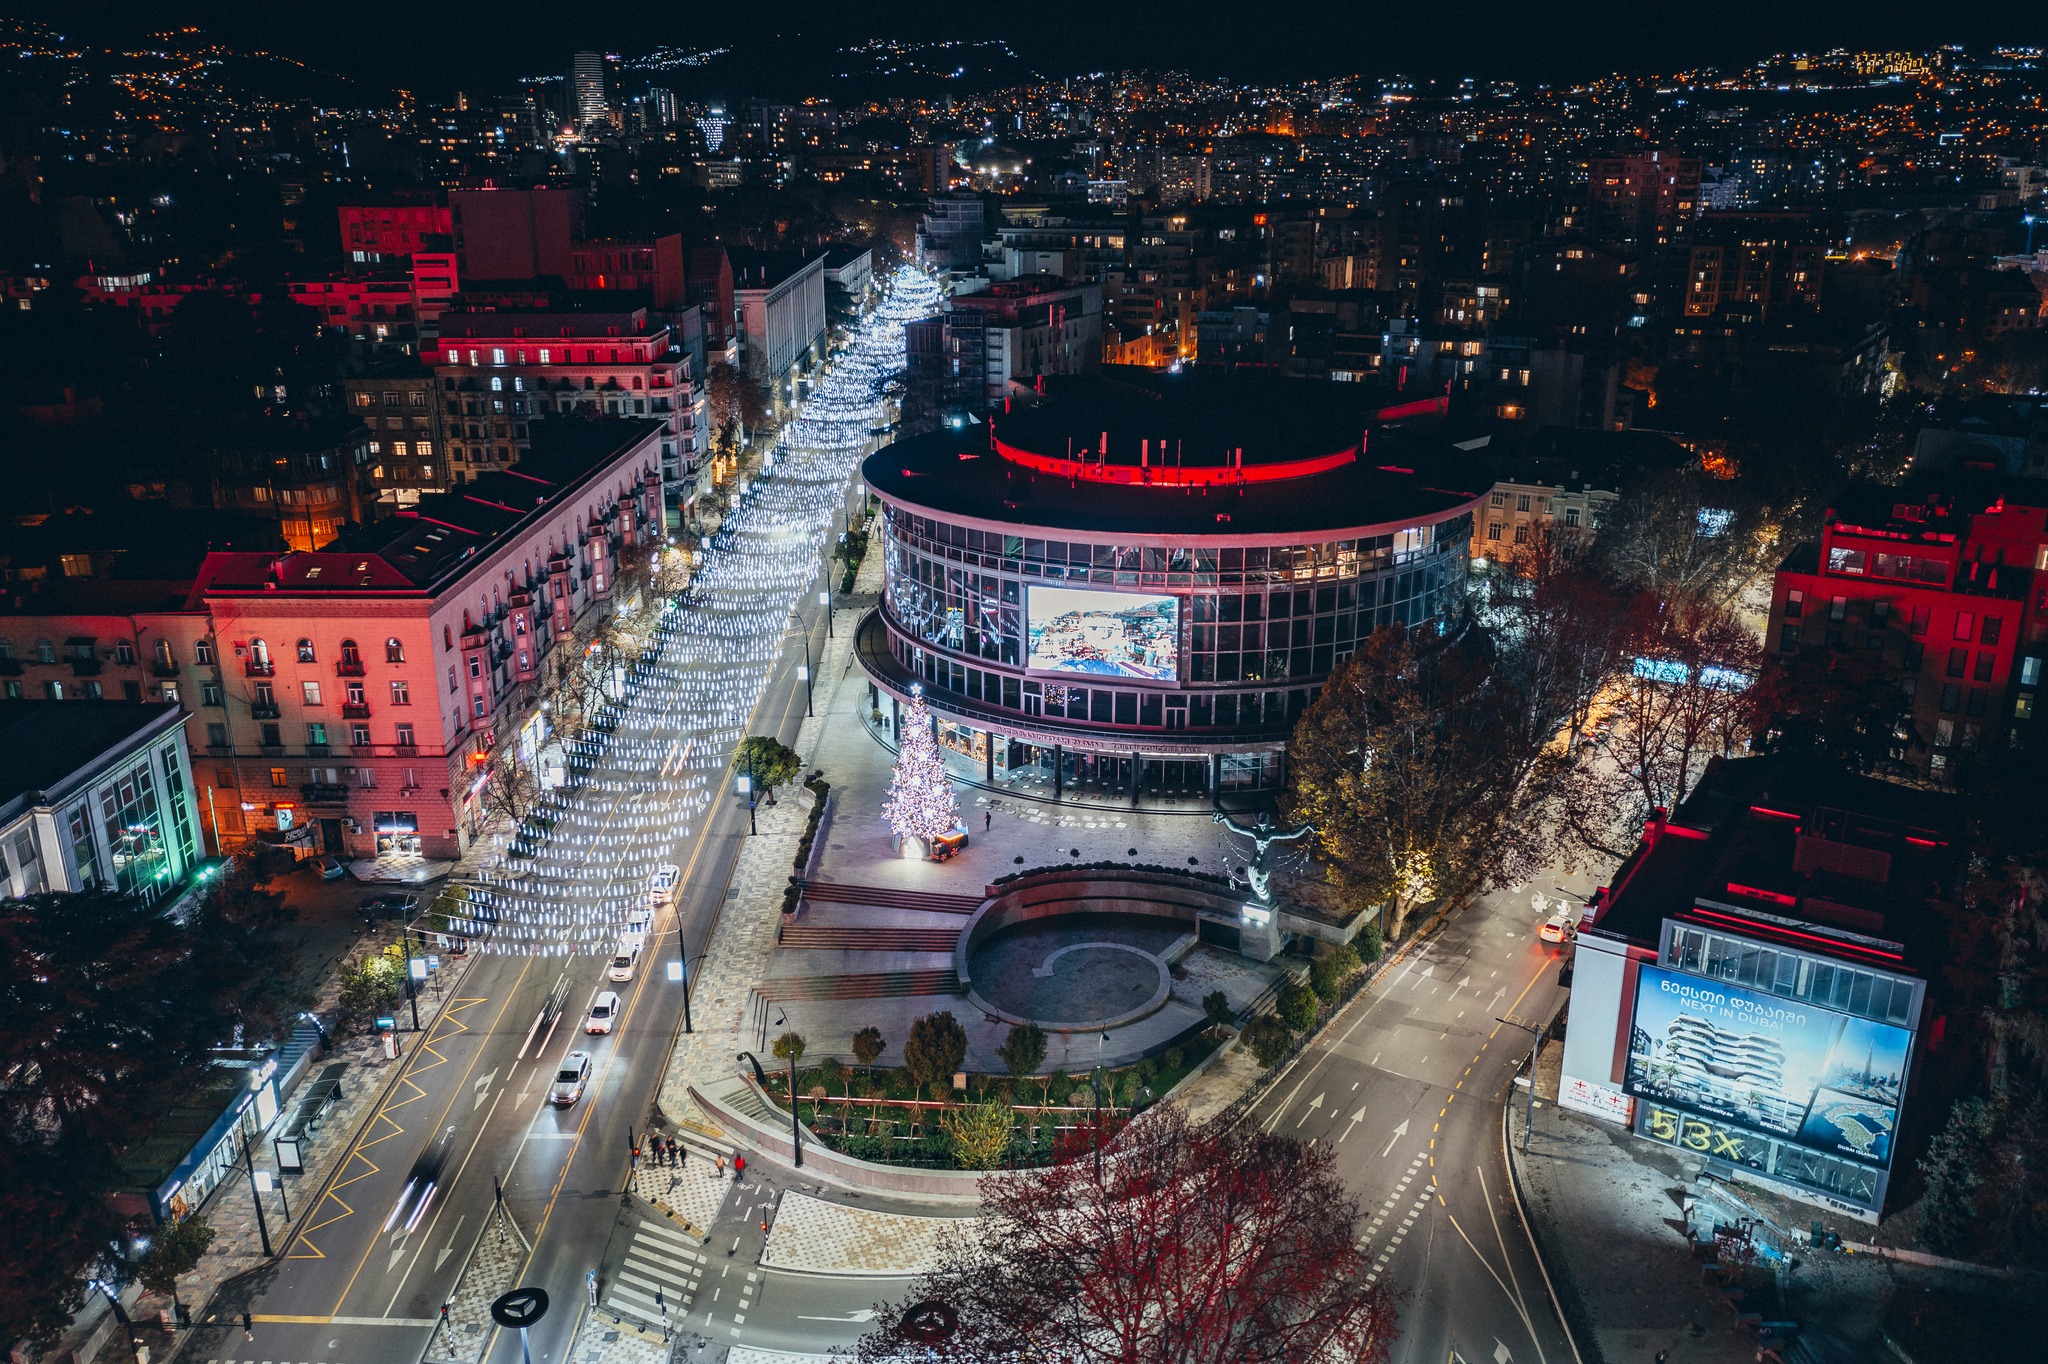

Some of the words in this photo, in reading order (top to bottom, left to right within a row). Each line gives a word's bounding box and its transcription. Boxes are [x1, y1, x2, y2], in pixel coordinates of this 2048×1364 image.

[1140, 745, 1176, 753] CONCERT
[1661, 980, 1725, 1006] ნექსთი
[1730, 997, 1806, 1026] დუბაიში
[1680, 997, 1716, 1014] NEXT
[1719, 1007, 1734, 1019] IN
[1738, 1012, 1783, 1031] DUBAI
[1643, 1087, 1671, 1099] NEXT
[1759, 1121, 1789, 1133] SPECTRUM
[1837, 1144, 1855, 1153] DUBAI
[1855, 1149, 1879, 1159] ISLANDS
